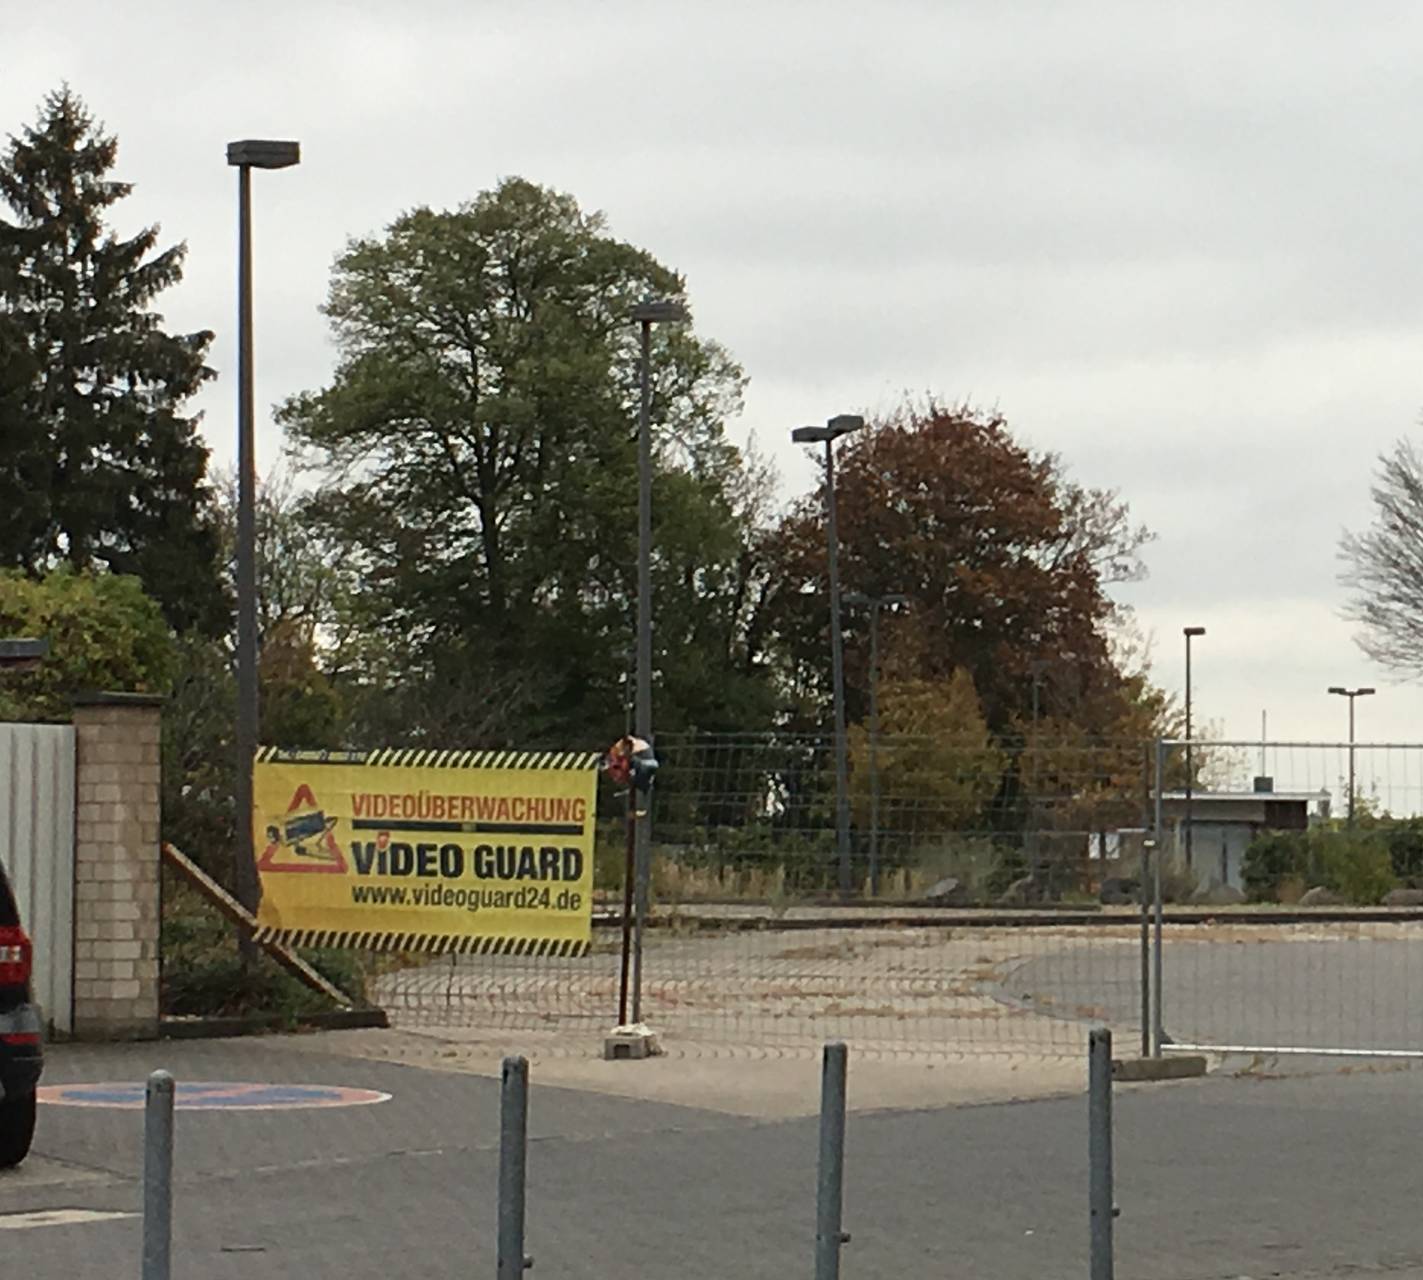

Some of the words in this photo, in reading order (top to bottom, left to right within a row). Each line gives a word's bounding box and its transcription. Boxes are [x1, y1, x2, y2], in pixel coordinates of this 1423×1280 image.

[352, 790, 586, 822] VIDEOÜBERWACHUNG
[474, 844, 584, 882] GUARD
[352, 882, 582, 912] www.videoguard24.de
